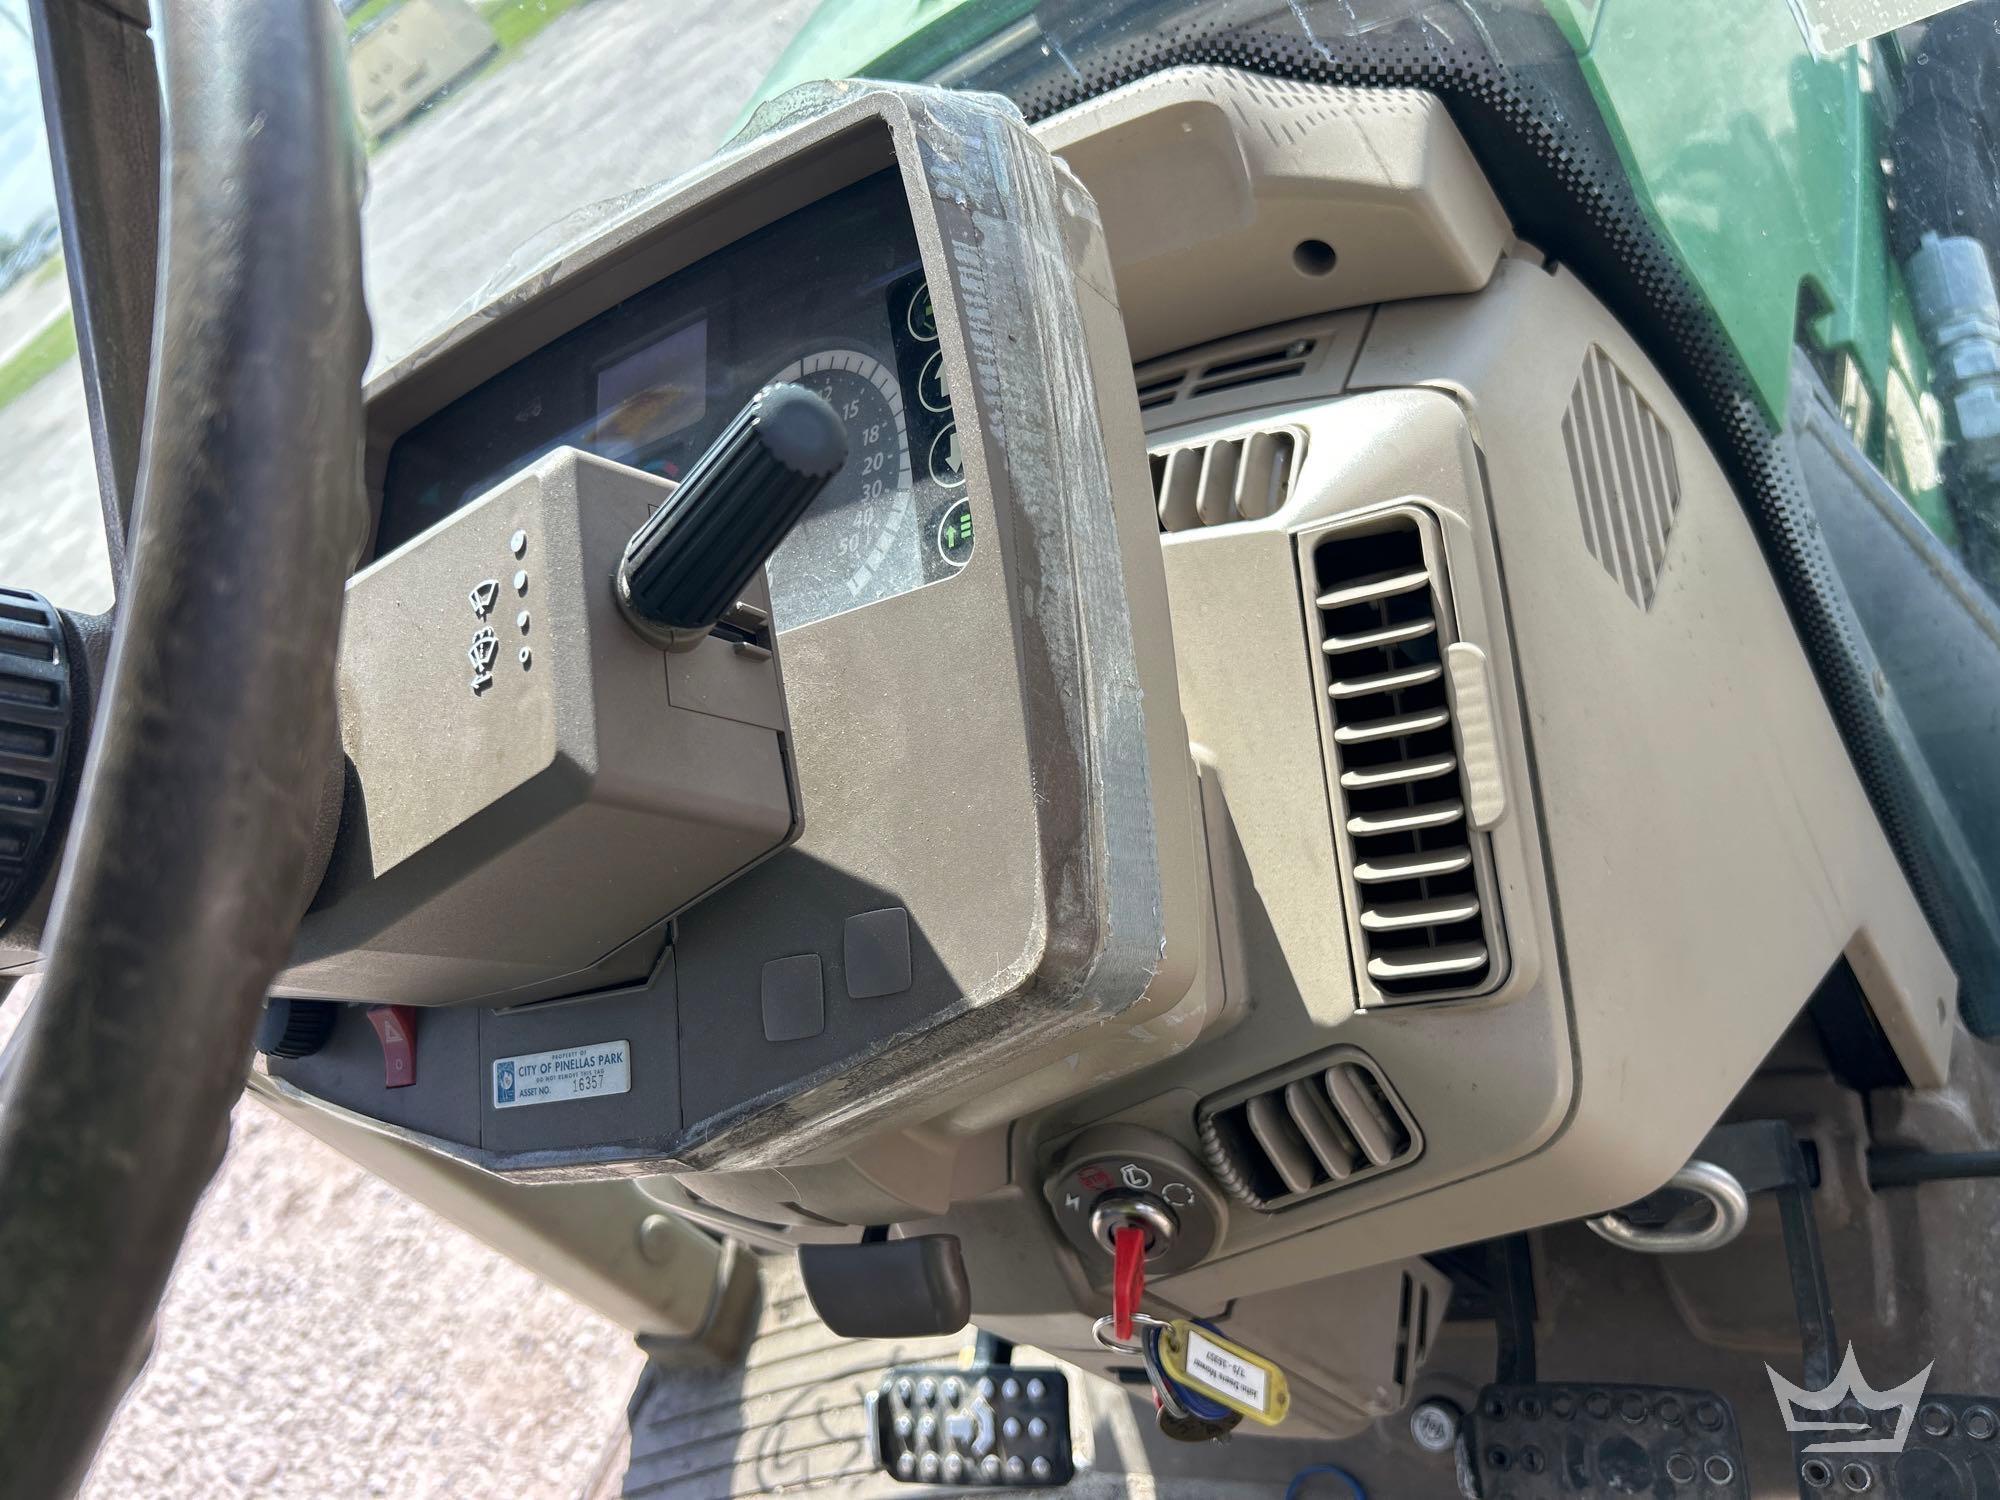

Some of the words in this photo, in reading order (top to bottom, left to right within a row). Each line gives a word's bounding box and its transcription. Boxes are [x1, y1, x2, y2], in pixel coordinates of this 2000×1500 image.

[842, 399, 860, 421] 15
[862, 424, 880, 446] 18
[861, 452, 883, 476] 20
[862, 480, 882, 502] 30
[853, 508, 873, 528] 40
[837, 533, 860, 557] 50
[518, 1064, 538, 1078] CITY
[540, 1062, 552, 1075] OF
[555, 1056, 596, 1073] PINELLAS
[598, 1051, 624, 1066] PARK
[551, 1051, 578, 1060] PROPERTY
[519, 1087, 538, 1098] ASSET
[539, 1085, 552, 1096] NO.
[573, 1074, 604, 1093] 16357
